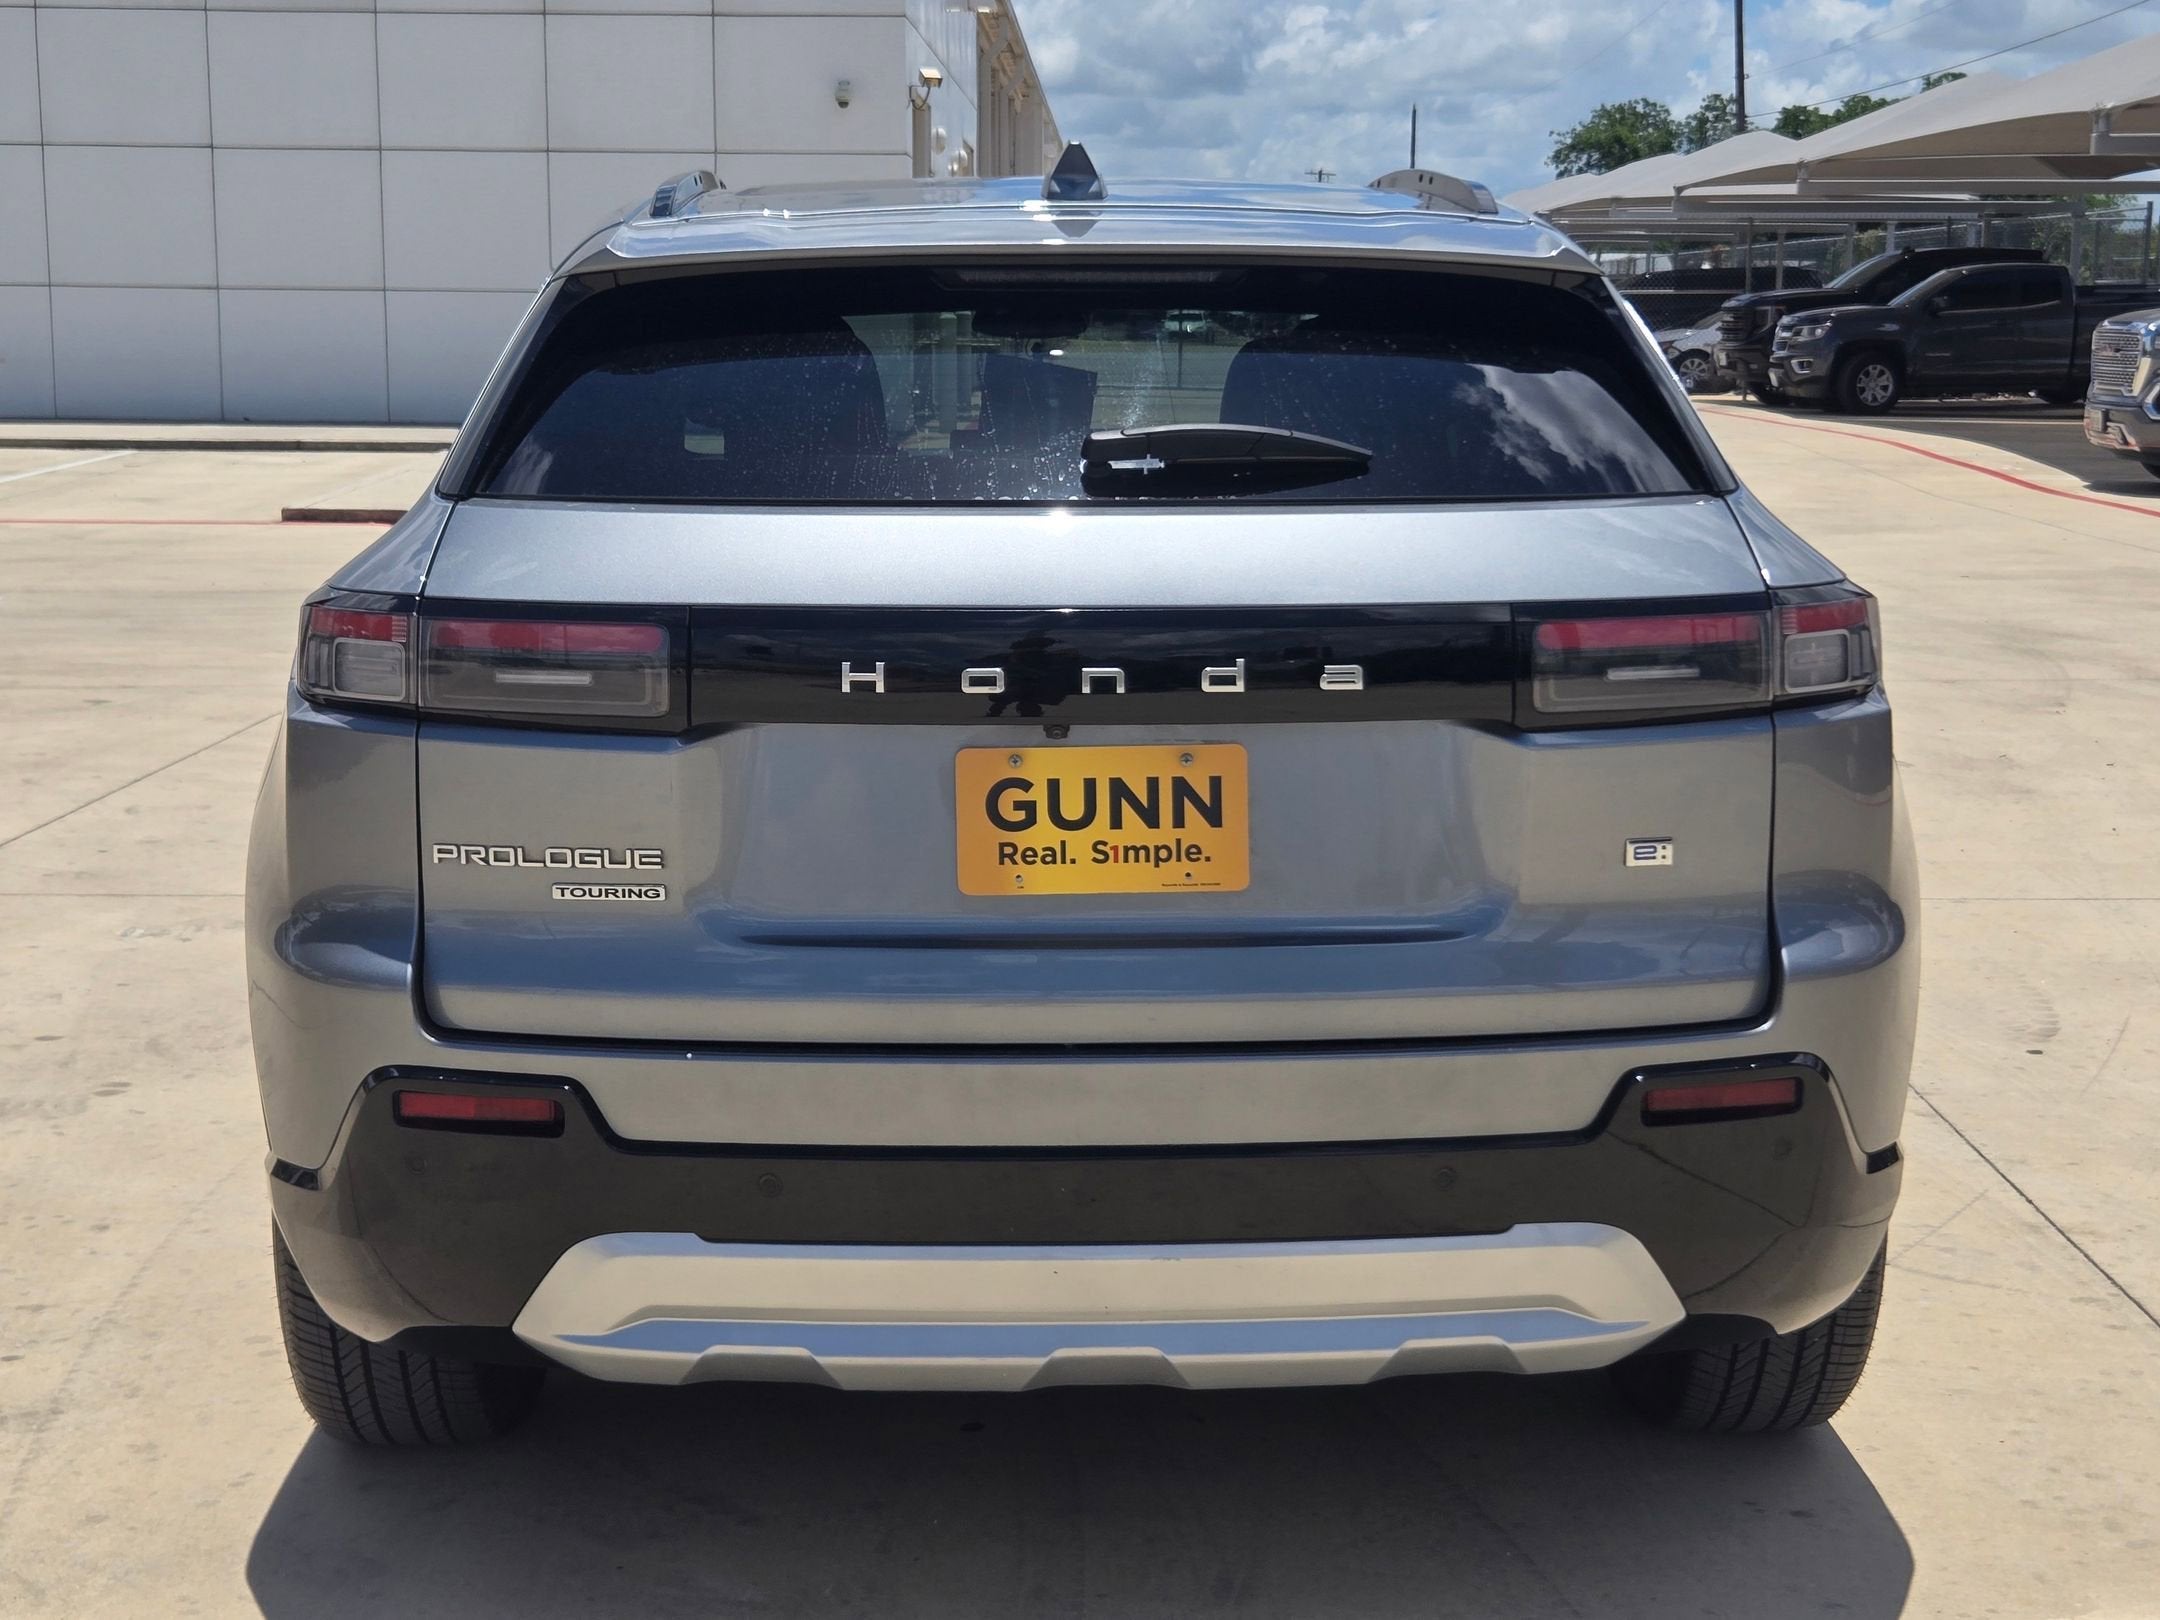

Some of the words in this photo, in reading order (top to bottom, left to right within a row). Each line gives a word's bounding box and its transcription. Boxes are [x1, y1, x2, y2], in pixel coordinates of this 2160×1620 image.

[841, 658, 1364, 694] Honda
[985, 775, 1223, 832] GUNN
[432, 844, 663, 870] PROLOGUE
[998, 840, 1076, 865] Real.
[1091, 838, 1211, 868] S1mple.
[555, 887, 661, 899] TOURING
